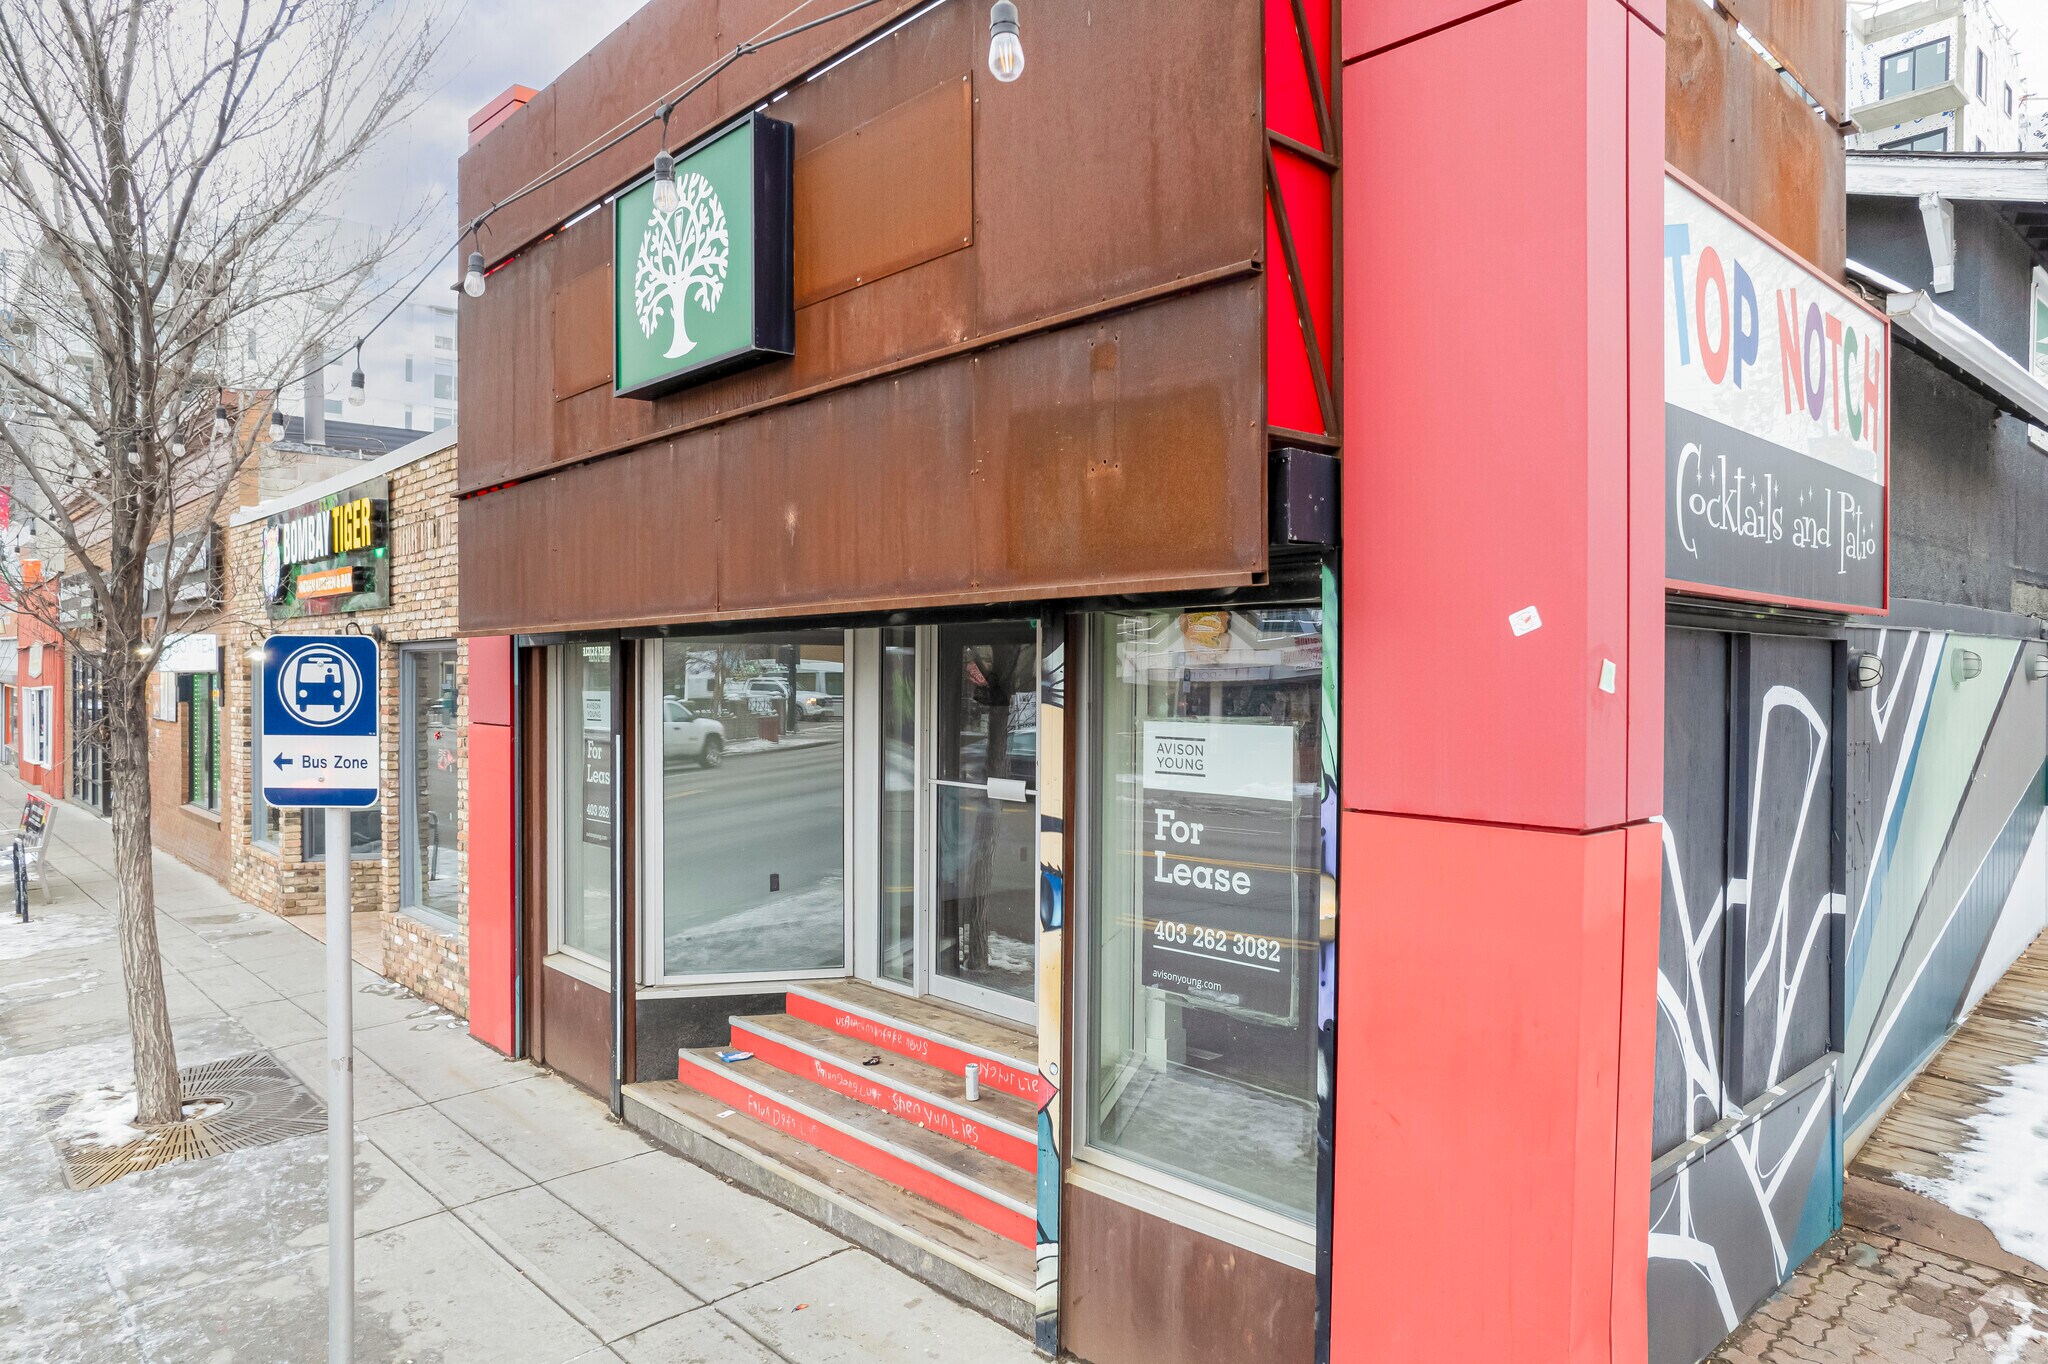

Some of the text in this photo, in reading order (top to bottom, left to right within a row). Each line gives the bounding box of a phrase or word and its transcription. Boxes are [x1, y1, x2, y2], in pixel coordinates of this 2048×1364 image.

[1664, 223, 1880, 455] TOP NOTCH
[1676, 442, 1876, 575] Cocktails and Patio
[283, 497, 372, 565] BOMBAY TIGER
[302, 755, 368, 769] Bus Zone
[587, 740, 602, 760] For
[1156, 743, 1204, 756] AVISON
[586, 763, 610, 785] Leas
[1157, 757, 1204, 771] YOUNG
[587, 803, 610, 818] 403 262
[1154, 808, 1204, 845] For
[1154, 851, 1251, 895] Lease
[1154, 920, 1281, 963] 403 262 3082
[1152, 969, 1222, 991] avisonyoung.com
[891, 1092, 920, 1114] Shen
[923, 1106, 948, 1127] Yun
